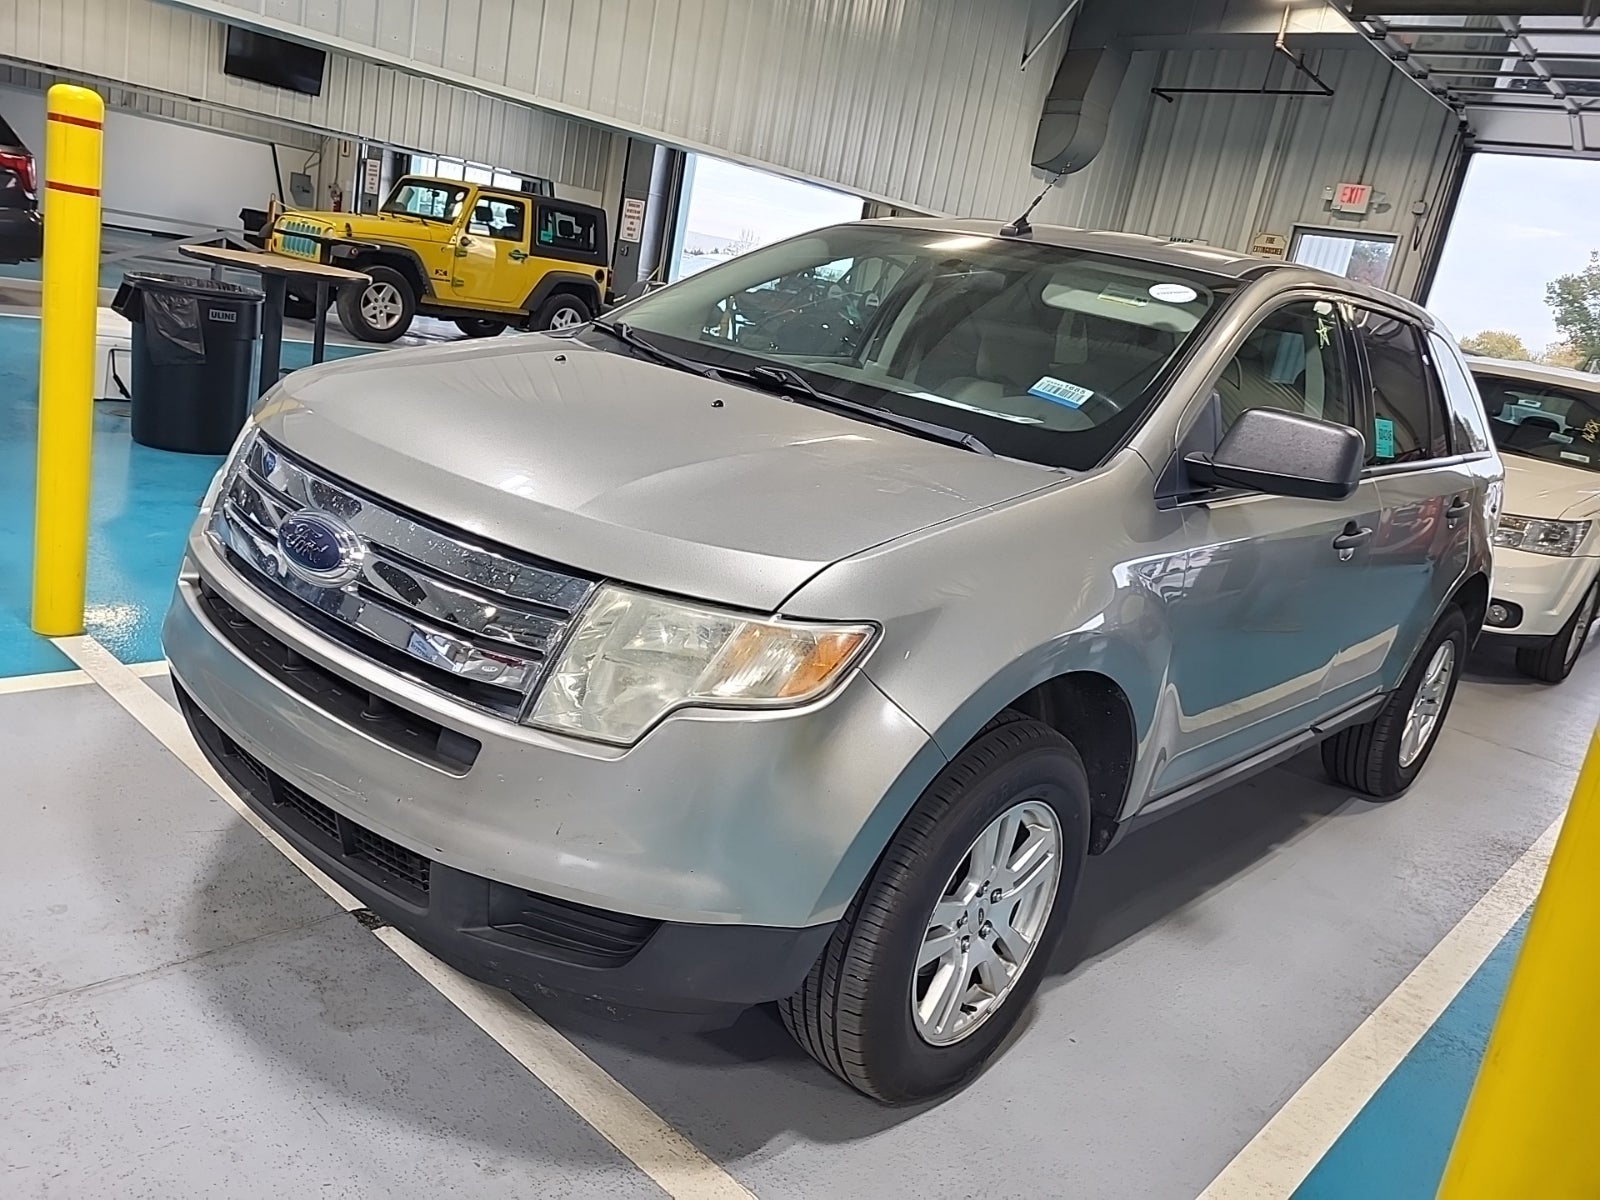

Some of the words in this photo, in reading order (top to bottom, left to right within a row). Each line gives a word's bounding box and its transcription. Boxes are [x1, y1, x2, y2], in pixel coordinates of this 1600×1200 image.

[1341, 186, 1366, 204] EXIT
[1265, 236, 1276, 244] FIRE
[211, 310, 236, 321] ULINE
[285, 522, 330, 564] Ford
